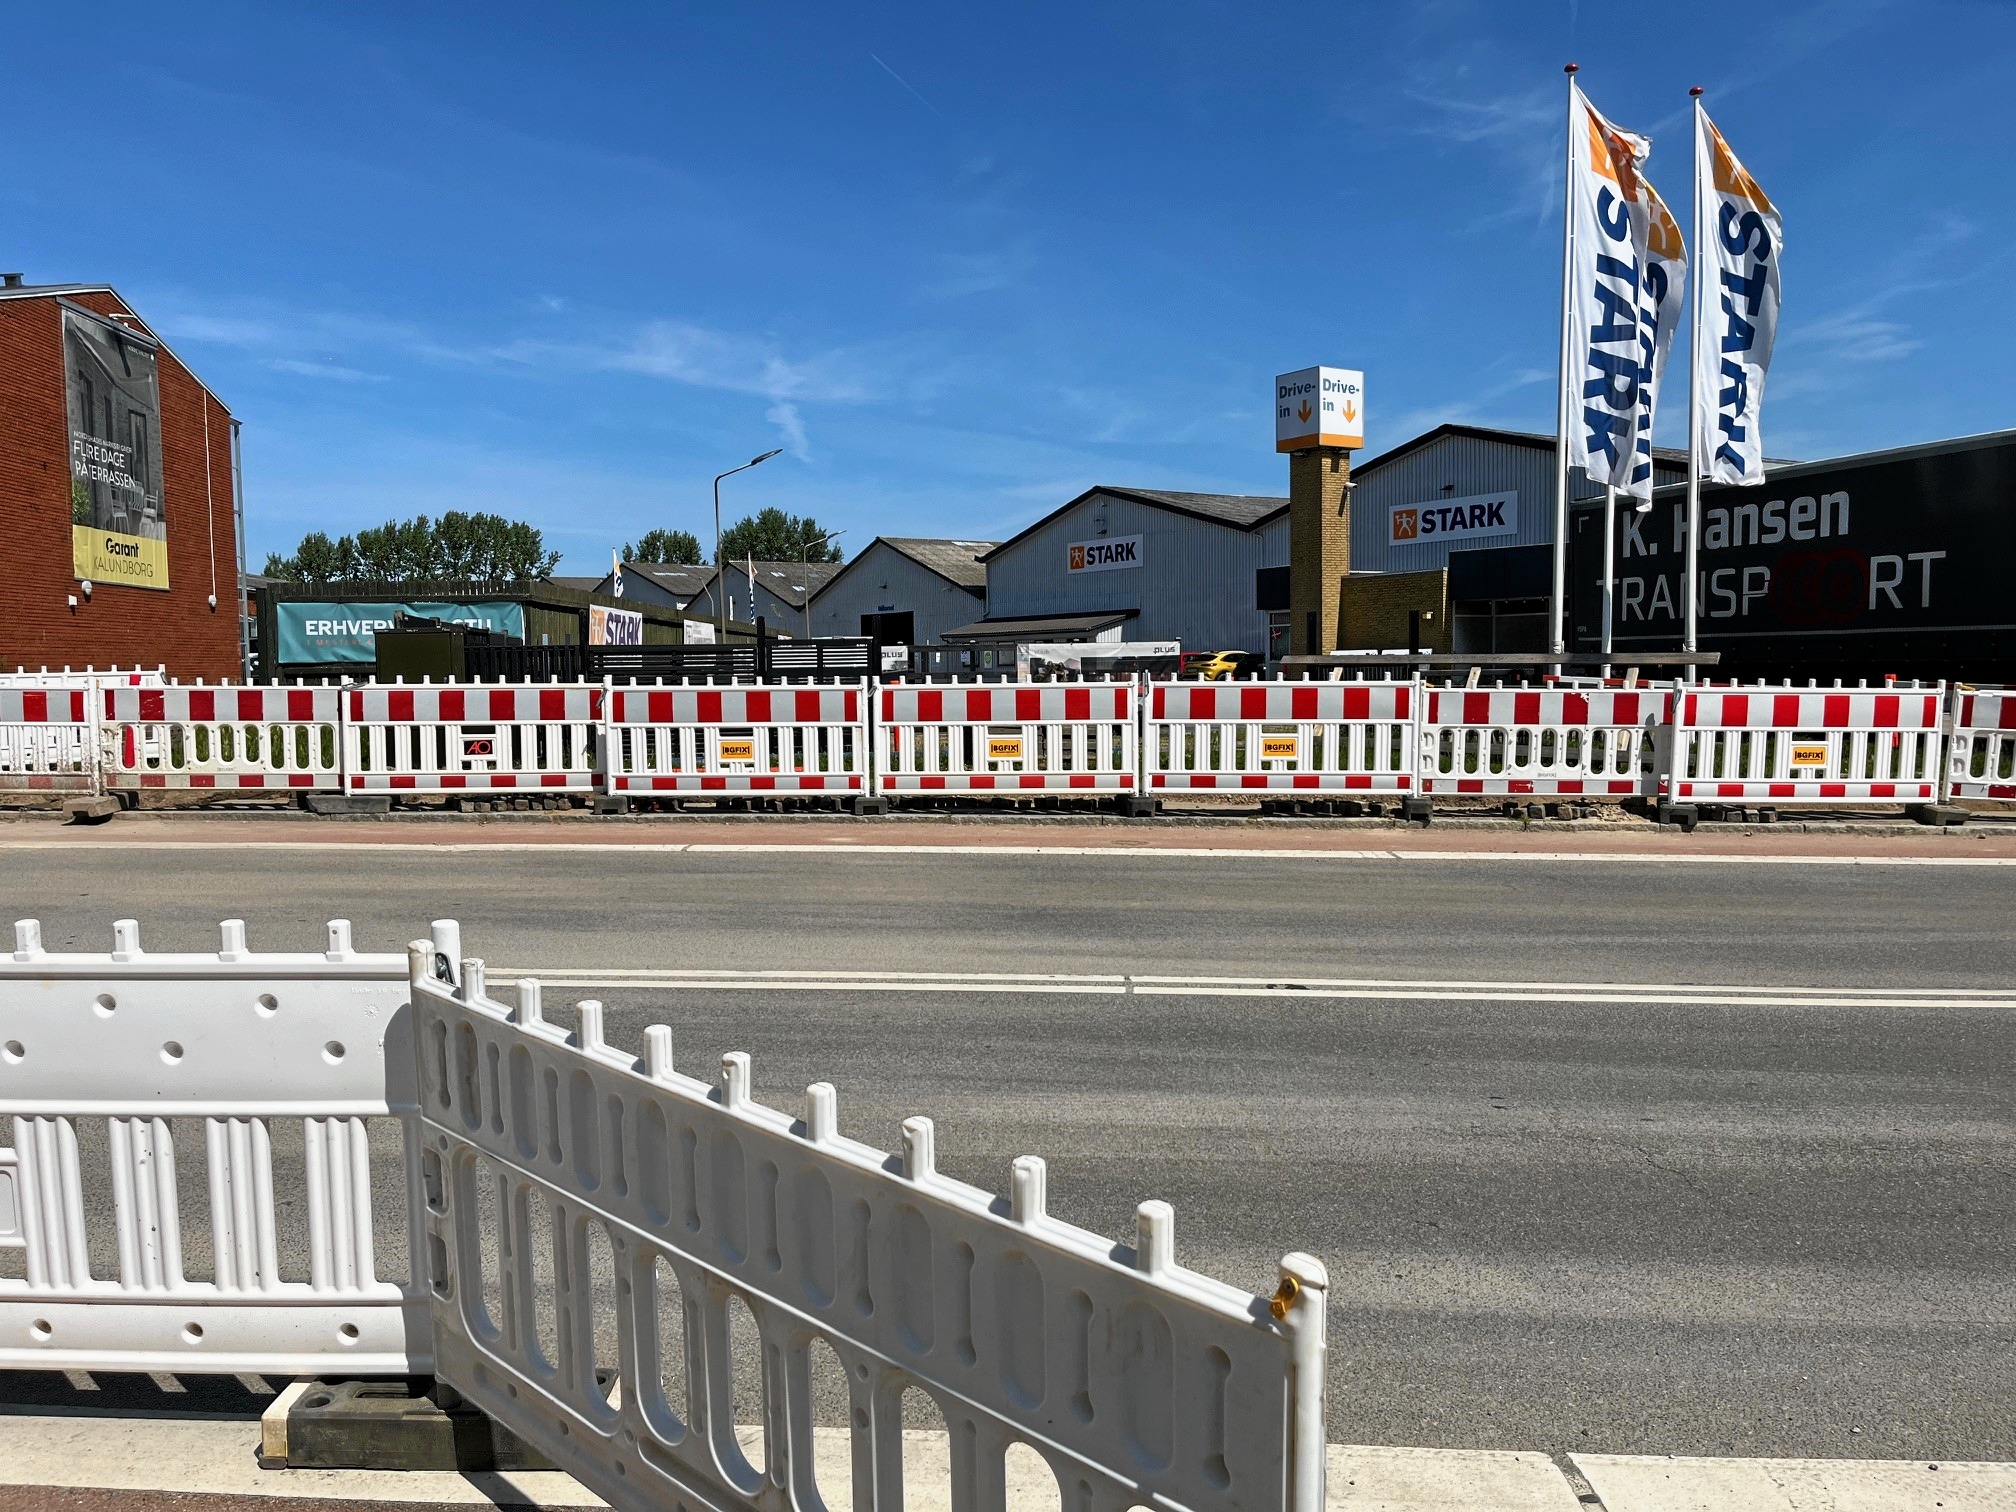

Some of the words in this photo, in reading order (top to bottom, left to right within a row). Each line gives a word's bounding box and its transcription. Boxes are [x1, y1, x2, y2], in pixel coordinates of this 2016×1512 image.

[1583, 184, 1640, 472] STARK
[1715, 200, 1772, 476] STARK
[1279, 383, 1316, 399] Drive-
[1322, 378, 1360, 394] Drive-
[1279, 405, 1291, 418] in
[1322, 398, 1335, 411] in
[101, 448, 125, 468] DAGE
[88, 464, 136, 488] TERRASSEN
[1421, 501, 1506, 534] STARK
[1673, 491, 1850, 553] Hansen
[105, 537, 140, 558] Garant
[1086, 541, 1137, 565] STARK
[93, 556, 153, 578] KALUNDBORG
[606, 611, 642, 646] STARK
